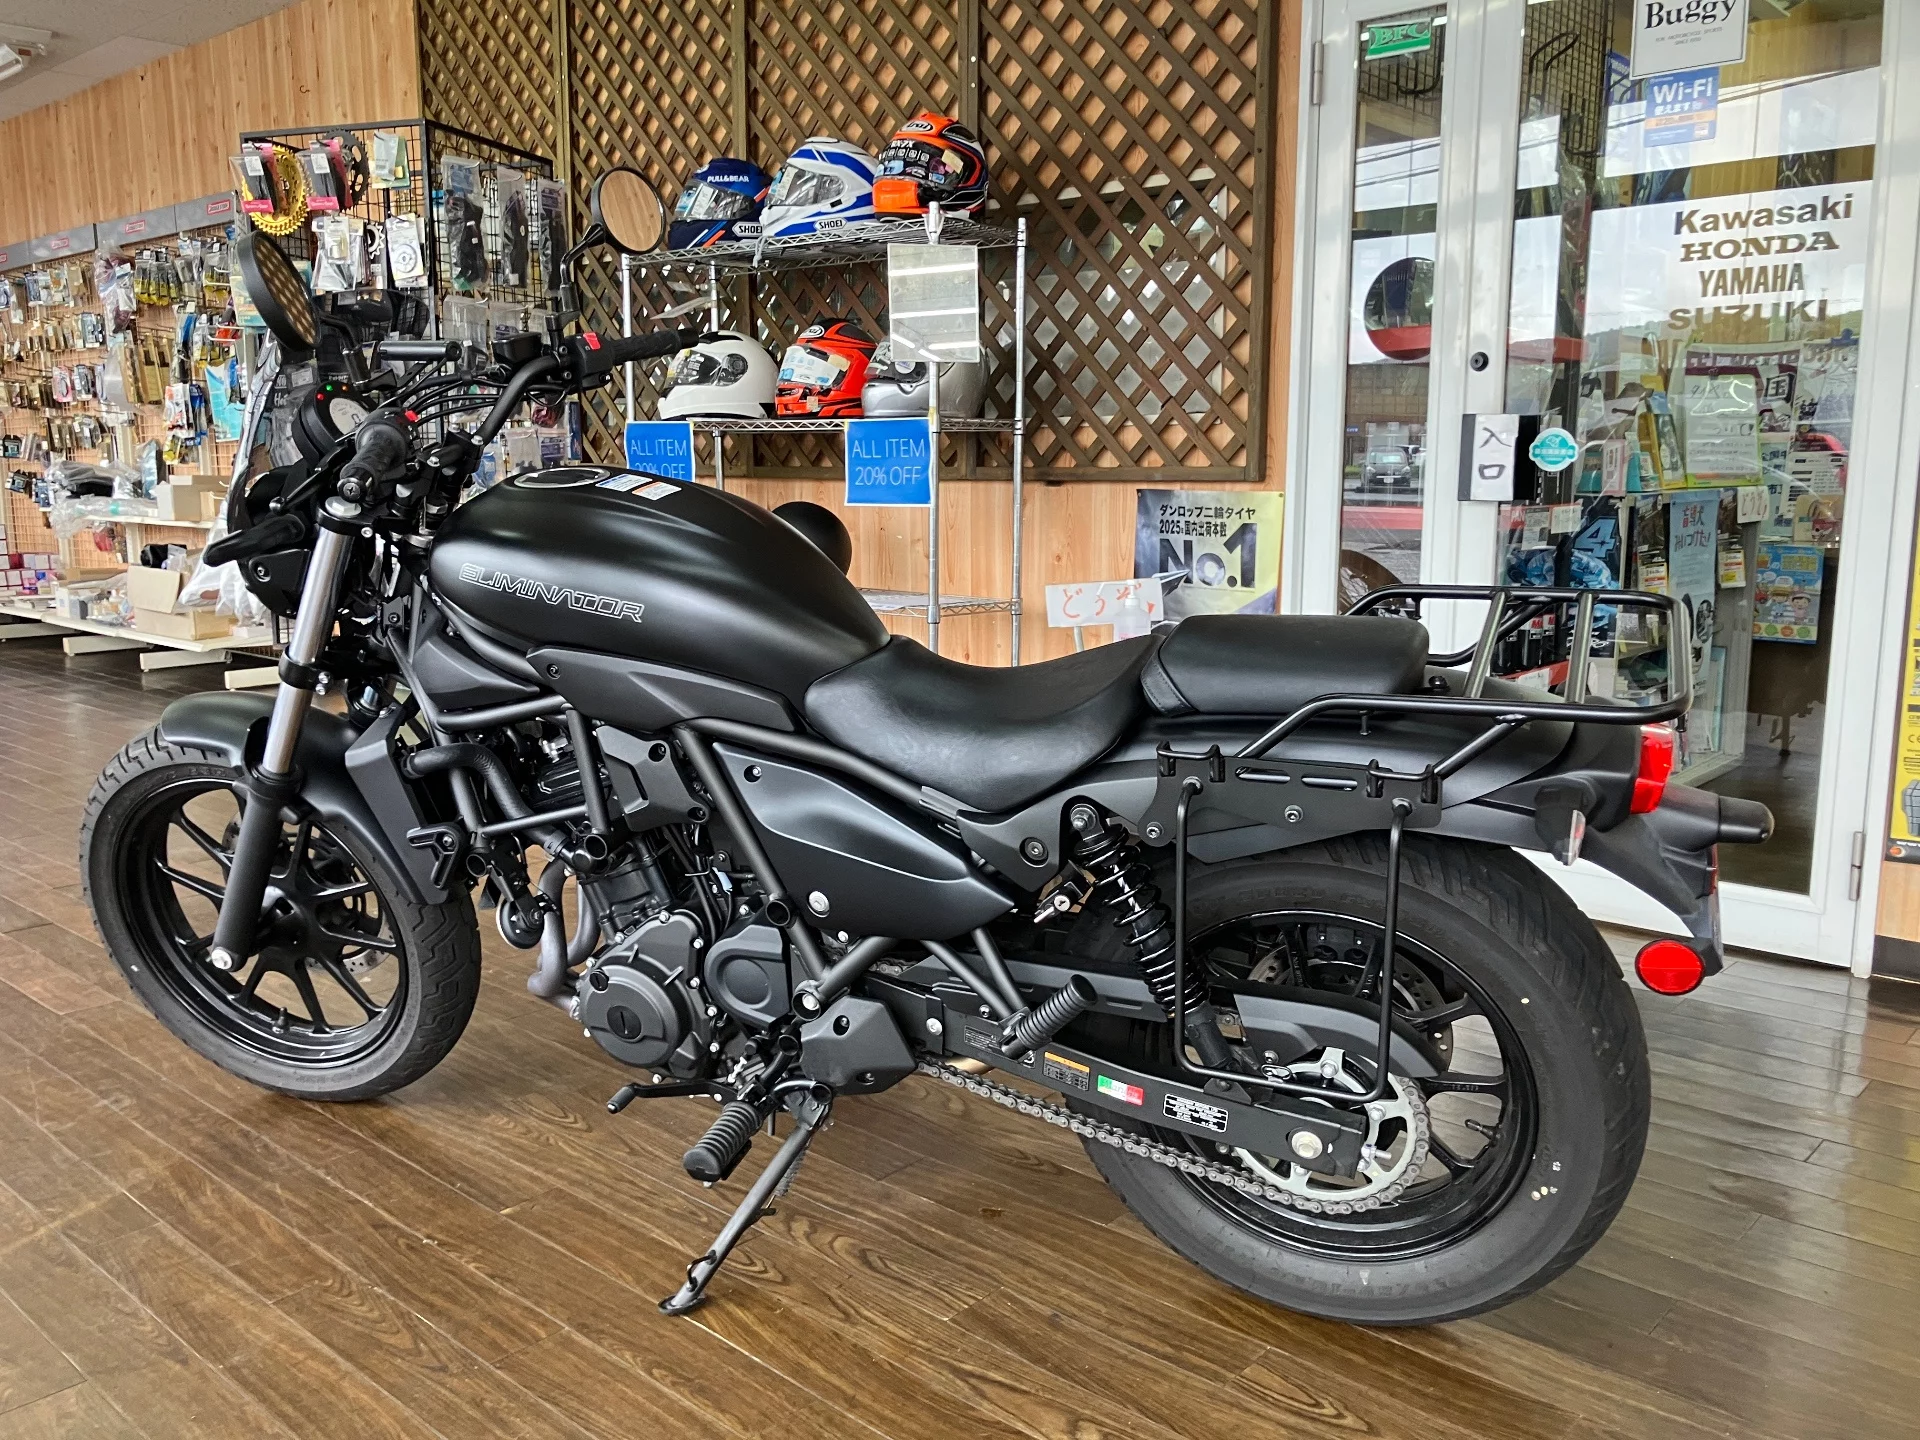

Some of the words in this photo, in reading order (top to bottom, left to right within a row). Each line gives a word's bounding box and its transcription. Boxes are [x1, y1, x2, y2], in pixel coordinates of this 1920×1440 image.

[1644, 0, 1738, 29] Buggy
[1653, 77, 1713, 104] Wi-Fi
[707, 174, 750, 183] PULL&BEAR
[818, 219, 843, 230] SHOEI
[1674, 192, 1854, 236] Kawasaki
[1680, 231, 1840, 262] HONDA
[1699, 263, 1805, 298] YAMAHA
[1667, 299, 1829, 331] SUZUKI
[630, 439, 653, 456] ALL
[655, 438, 687, 456] ITEM
[852, 439, 882, 459] ALL
[885, 438, 926, 458] ITEM
[1478, 426, 1513, 481] 入口
[661, 463, 686, 479] OFF
[854, 467, 887, 486] 20%
[890, 466, 922, 485] OFF
[1160, 504, 1256, 520] ダンロップ二輪タイヤ
[1159, 522, 1258, 588] No.1
[458, 562, 646, 624] ELIMINATOR
